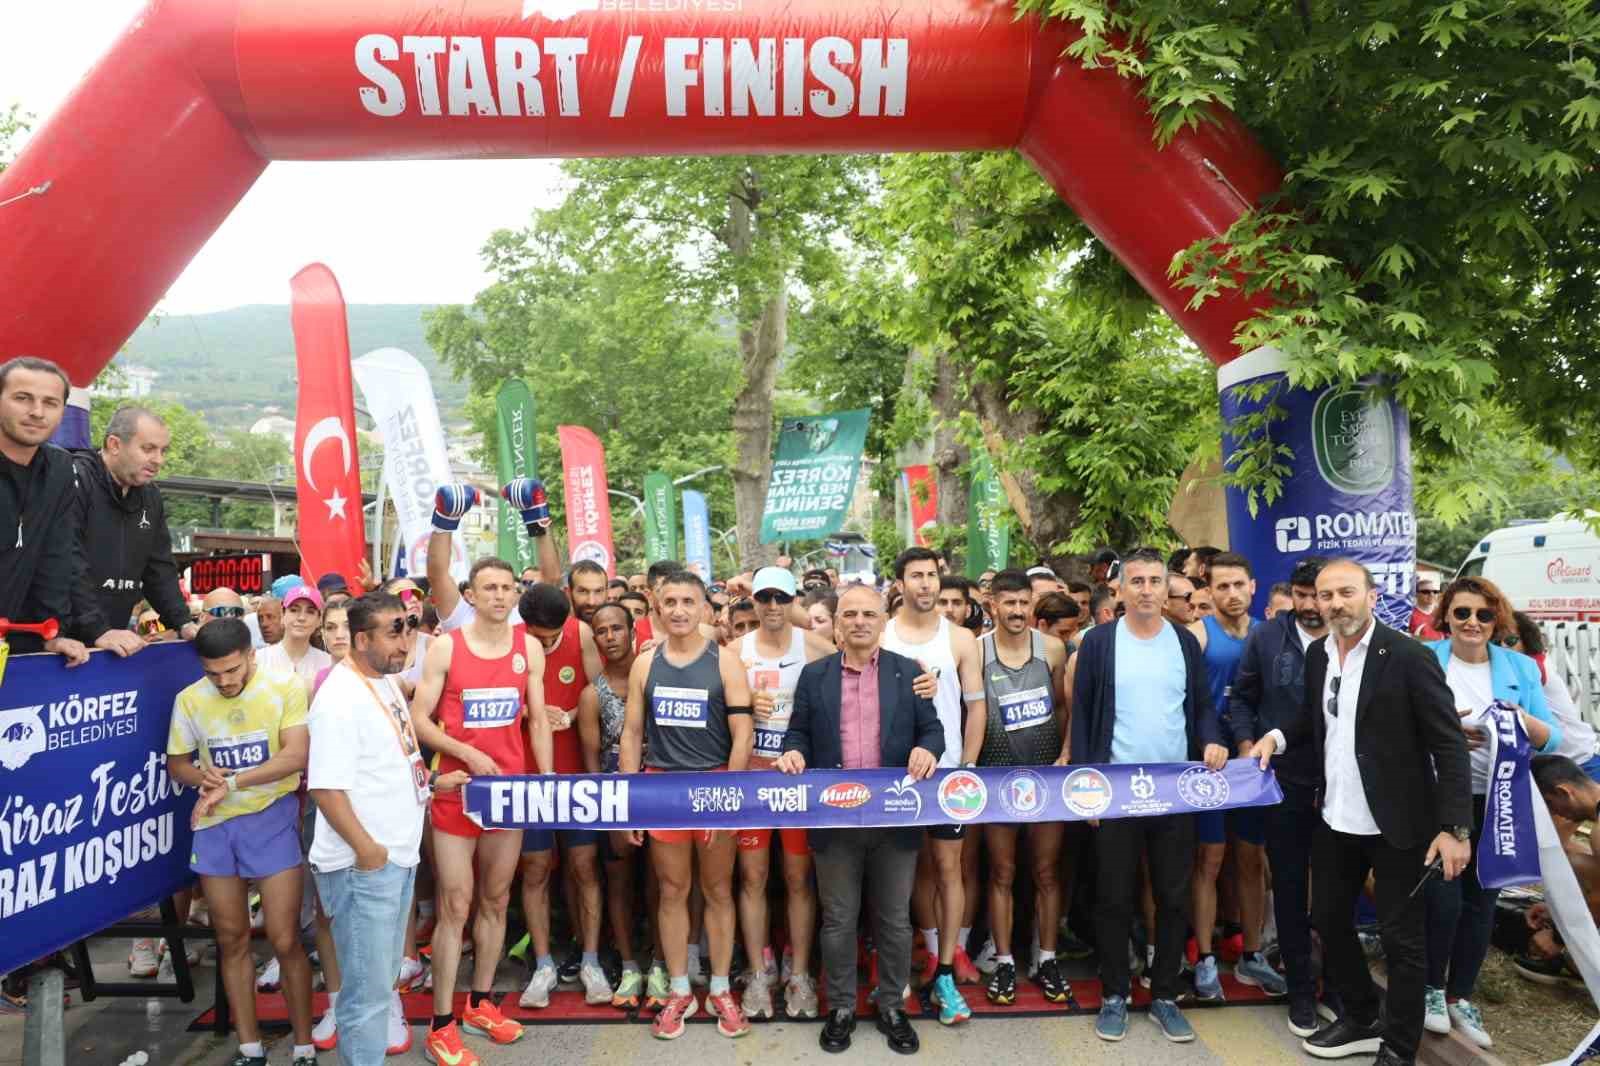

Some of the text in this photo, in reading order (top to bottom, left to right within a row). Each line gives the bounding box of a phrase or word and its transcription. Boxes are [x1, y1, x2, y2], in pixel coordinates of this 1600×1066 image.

[355, 34, 909, 118] START / FINISH
[102, 578, 134, 589] AIR
[48, 690, 138, 728] KÖRFEZ
[468, 701, 514, 719] 41377
[656, 700, 701, 718] 41355
[1006, 700, 1047, 721] 41458
[48, 717, 137, 750] BELEDİYESİ
[214, 745, 263, 767] 41143
[489, 779, 629, 824] FINISH
[688, 786, 745, 801] MERHABA
[819, 784, 868, 804] Mutlu
[1499, 780, 1516, 857] ROMATEM
[64, 811, 174, 894] KOŞUSU
